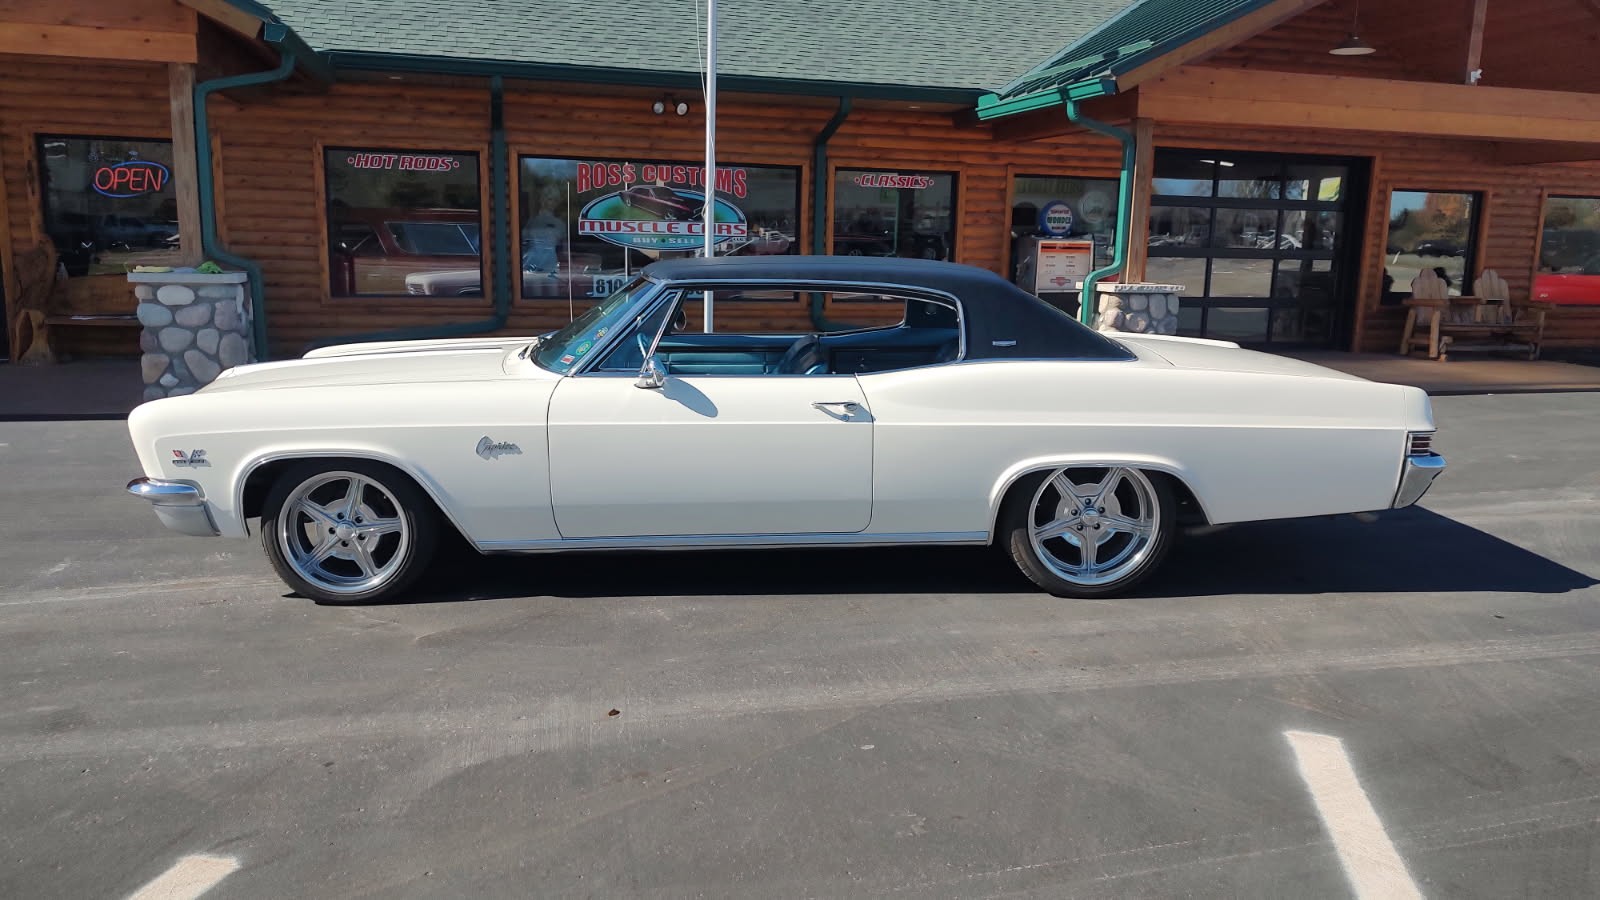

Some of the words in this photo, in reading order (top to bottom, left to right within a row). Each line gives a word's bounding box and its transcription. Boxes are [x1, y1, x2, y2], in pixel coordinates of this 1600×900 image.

[354, 154, 398, 170] HOT
[399, 155, 454, 172] RODS
[95, 167, 163, 192] OPEN
[577, 162, 637, 193] ROSS
[860, 173, 930, 190] CLASSICS
[579, 220, 681, 234] MUSCLE
